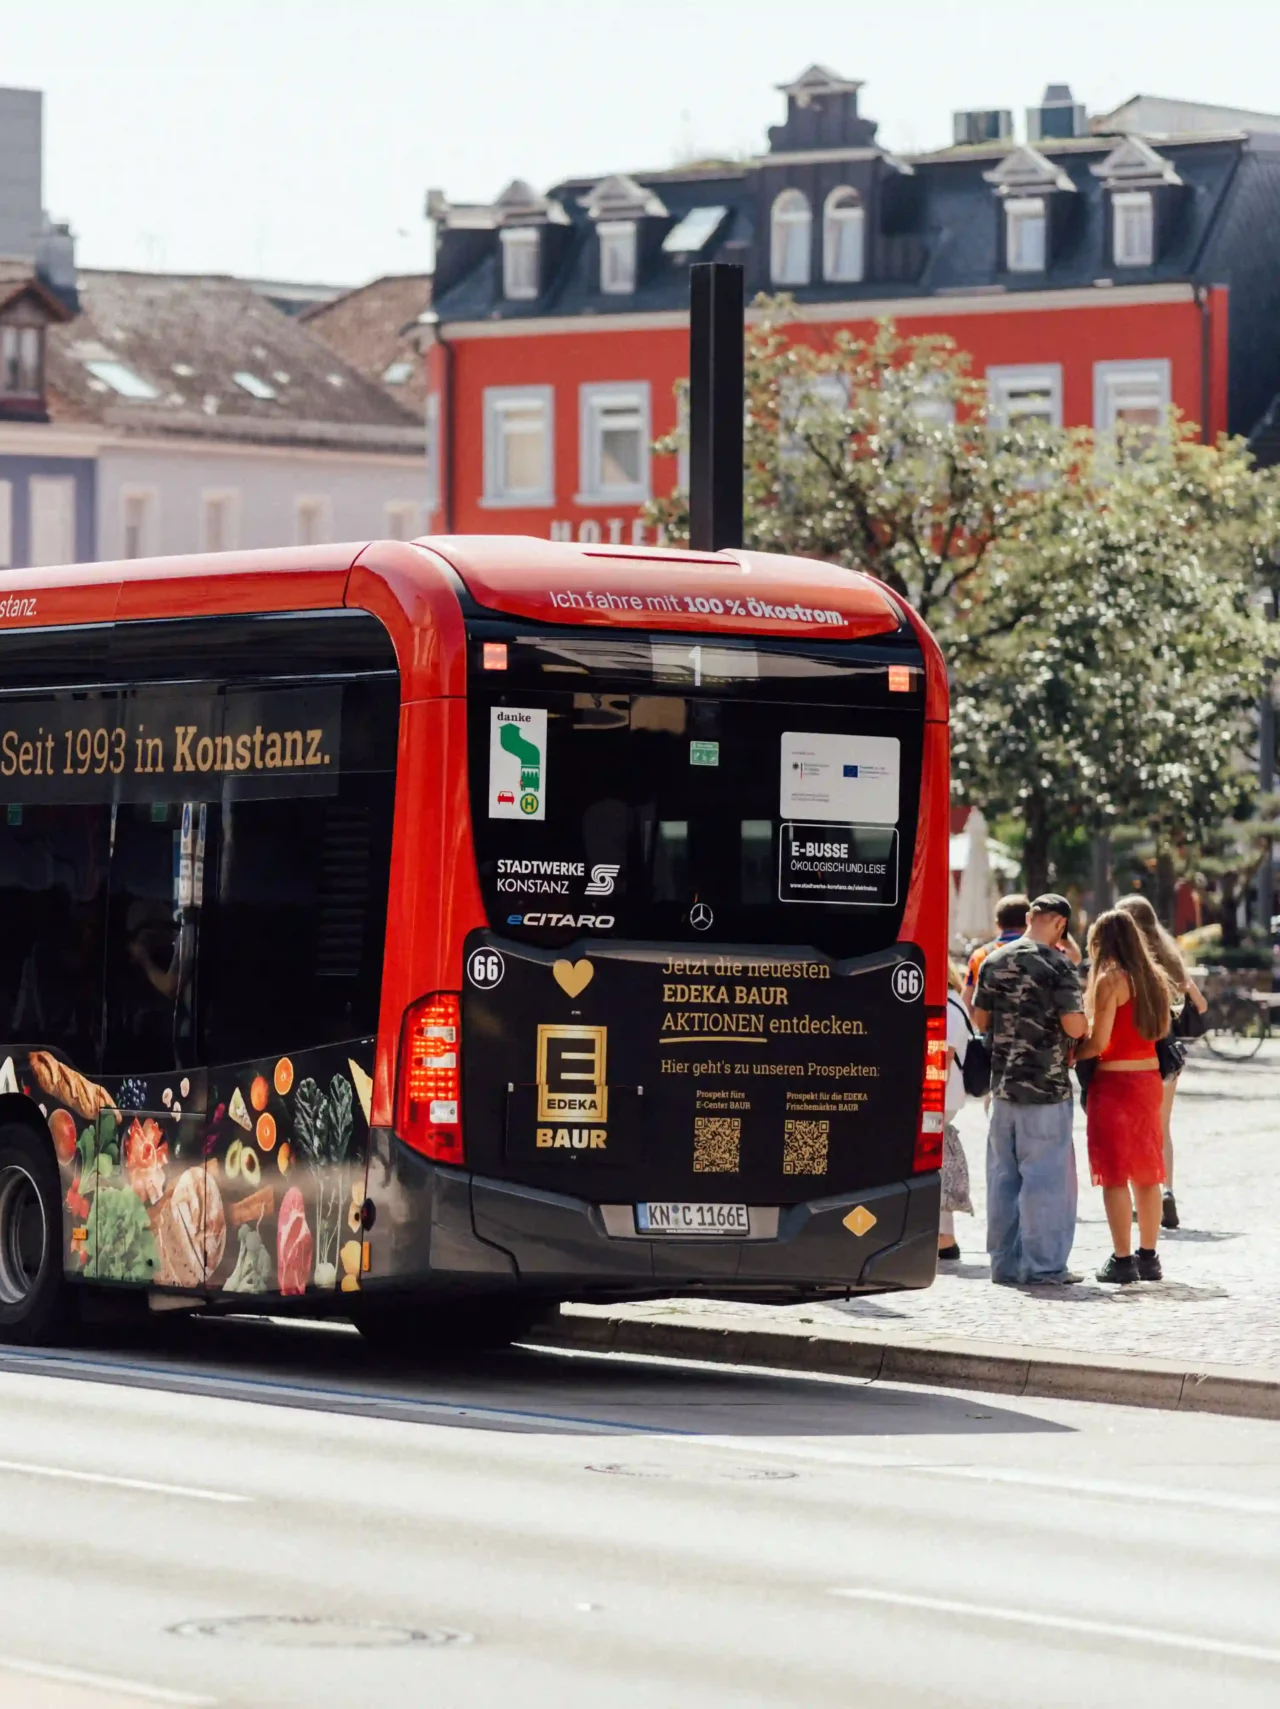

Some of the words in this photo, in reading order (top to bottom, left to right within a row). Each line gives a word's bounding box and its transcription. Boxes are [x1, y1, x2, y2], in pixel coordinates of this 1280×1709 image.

[550, 591, 583, 609] Ich
[586, 591, 644, 611] fahre
[647, 595, 683, 612] mit
[684, 596, 725, 615] 100
[726, 599, 746, 616] %
[746, 597, 849, 626] Ökostrom.
[688, 645, 702, 687] 1
[497, 711, 532, 723] danke
[0, 727, 56, 776] Seit
[63, 728, 127, 775] 1993
[134, 724, 165, 773] in
[173, 724, 331, 772] Konstanz.
[791, 841, 849, 858] E-BUSSE
[497, 859, 585, 876] STADTWERKE
[790, 860, 845, 873] ÖKOLOGISCH
[845, 863, 864, 873] UND
[864, 863, 887, 875] LEISE
[497, 878, 569, 895] KONSTANZ
[507, 913, 616, 928] eCITARO
[473, 955, 499, 981] 66
[662, 957, 709, 976] Jetzt
[714, 957, 743, 977] die
[747, 961, 831, 979] neuesten
[897, 969, 919, 994] 66
[662, 984, 730, 1004] EDEKA
[734, 986, 789, 1005] BAUR
[661, 1012, 765, 1033] AKTIONEN
[769, 1015, 868, 1035] entdecken.
[661, 1060, 690, 1074] Hier
[692, 1060, 731, 1077] geht's
[734, 1063, 750, 1075] zu
[752, 1063, 805, 1076] unseren
[807, 1062, 881, 1079] Prospekten:
[696, 1090, 729, 1100] Prospekt
[730, 1090, 746, 1099] fürs
[786, 1092, 818, 1102] Prospekt
[819, 1092, 830, 1100] für
[830, 1092, 842, 1101] die
[843, 1093, 868, 1101] EDEKA
[547, 1099, 598, 1111] EDEKA
[696, 1101, 728, 1109] E-Center
[729, 1102, 751, 1110] BAUR
[786, 1102, 837, 1111] Frischemärkte
[838, 1103, 859, 1112] BAUR
[536, 1128, 608, 1149] BAUR
[649, 1205, 671, 1226] KN
[682, 1206, 693, 1226] C
[696, 1206, 747, 1227] 1166E
